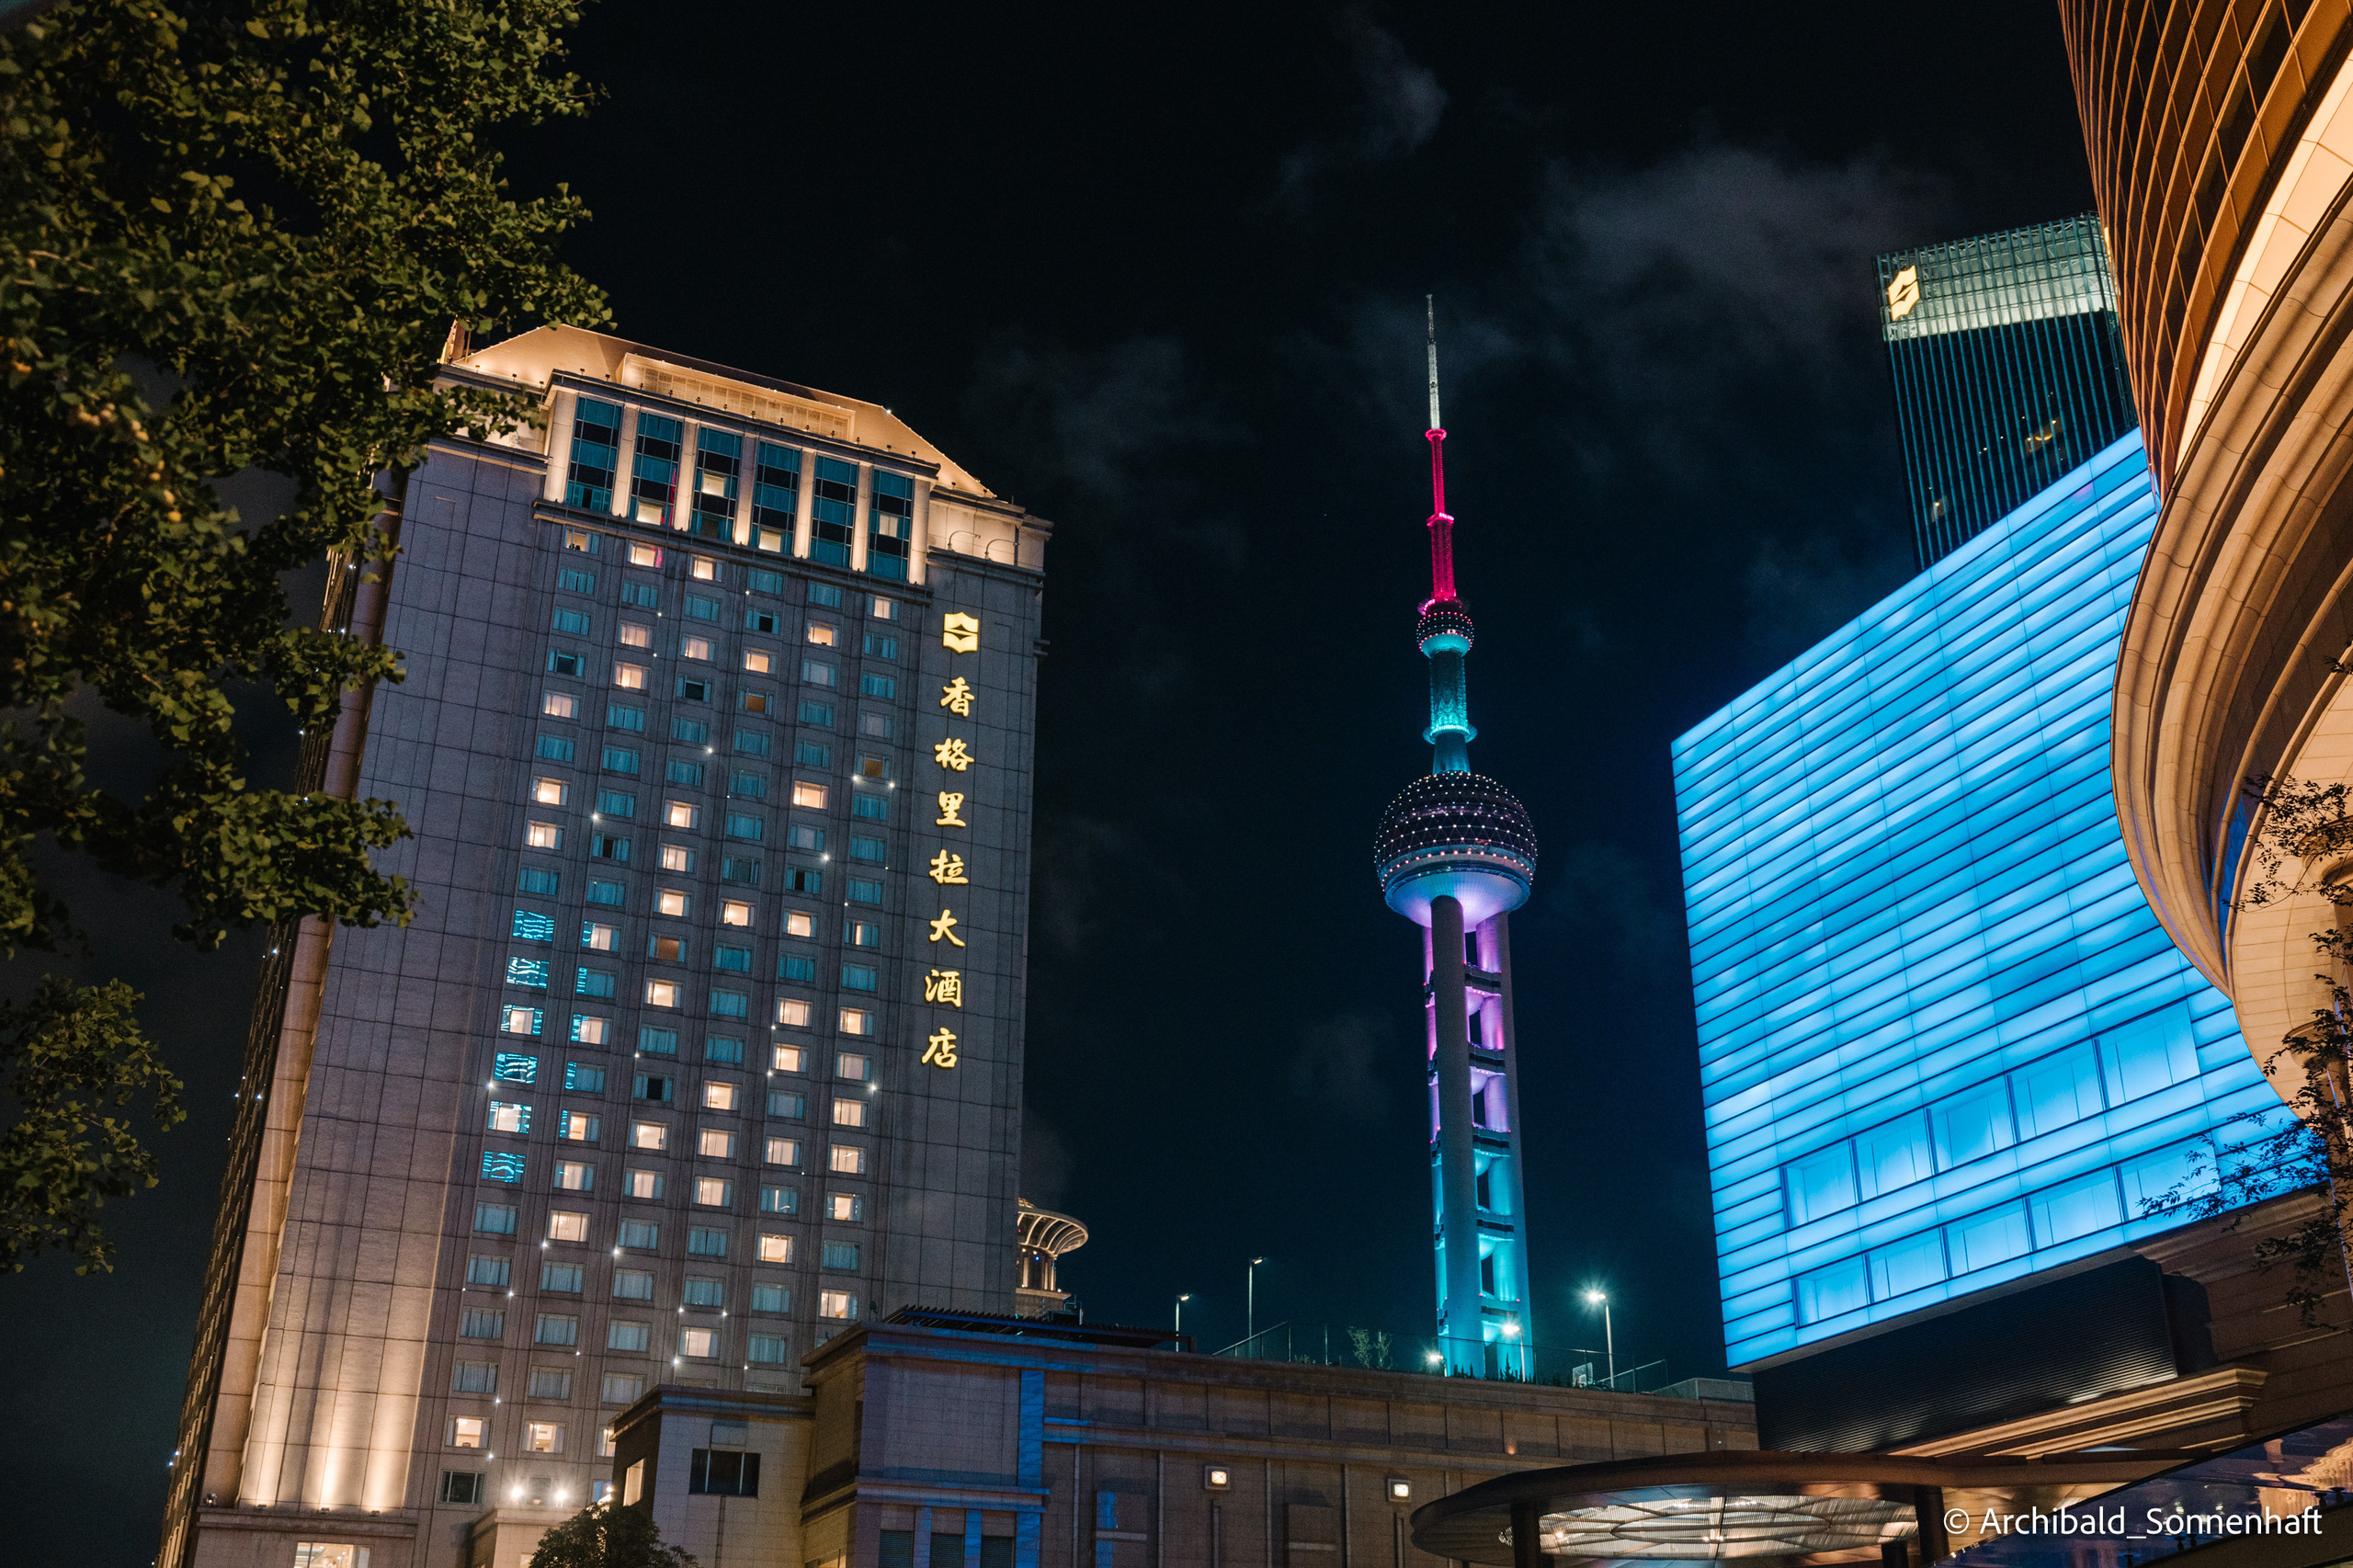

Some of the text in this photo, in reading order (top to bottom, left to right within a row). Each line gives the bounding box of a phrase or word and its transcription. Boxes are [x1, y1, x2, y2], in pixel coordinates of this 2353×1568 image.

[922, 677, 974, 1067] 香格里拉大酒店
